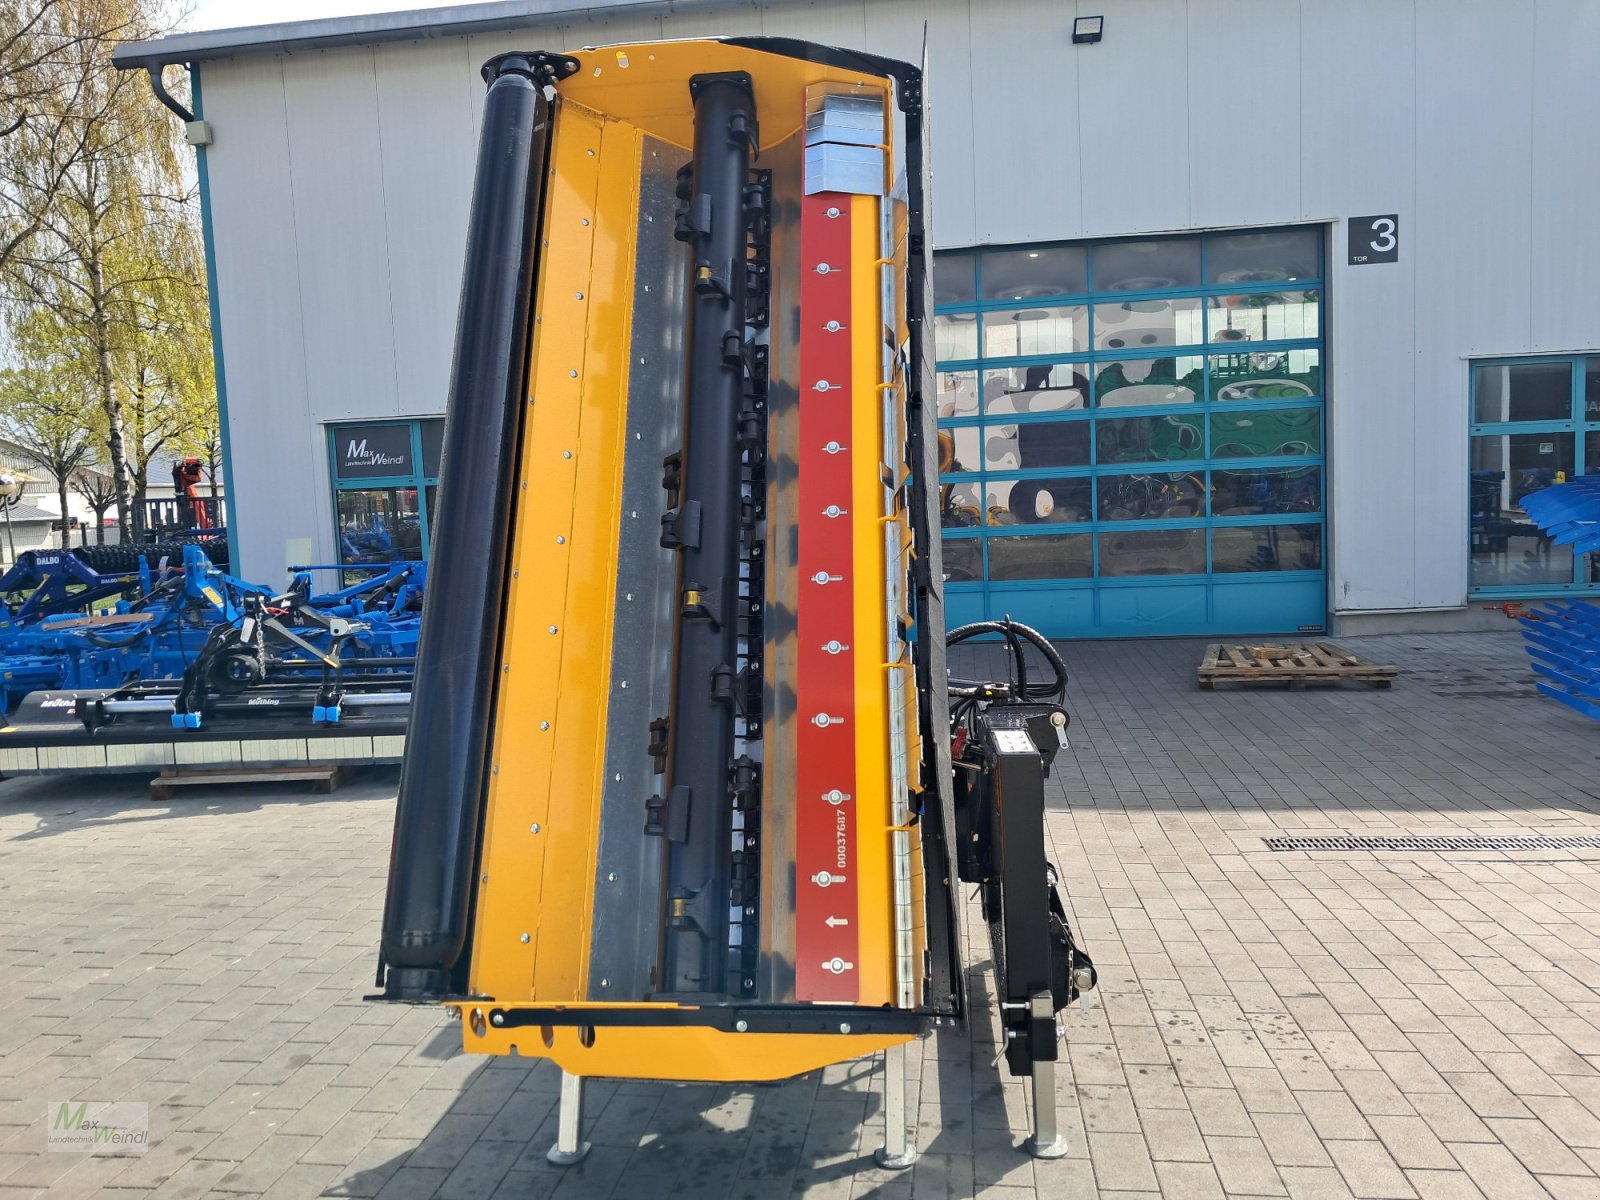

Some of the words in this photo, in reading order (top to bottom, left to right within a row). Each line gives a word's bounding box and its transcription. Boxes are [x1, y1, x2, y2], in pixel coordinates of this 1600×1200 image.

[1370, 218, 1396, 252] 3
[347, 439, 374, 458] Max
[371, 453, 404, 465] Weindl
[36, 556, 59, 566] DALBO
[247, 697, 280, 706] Müthing
[836, 809, 846, 868] 00037687
